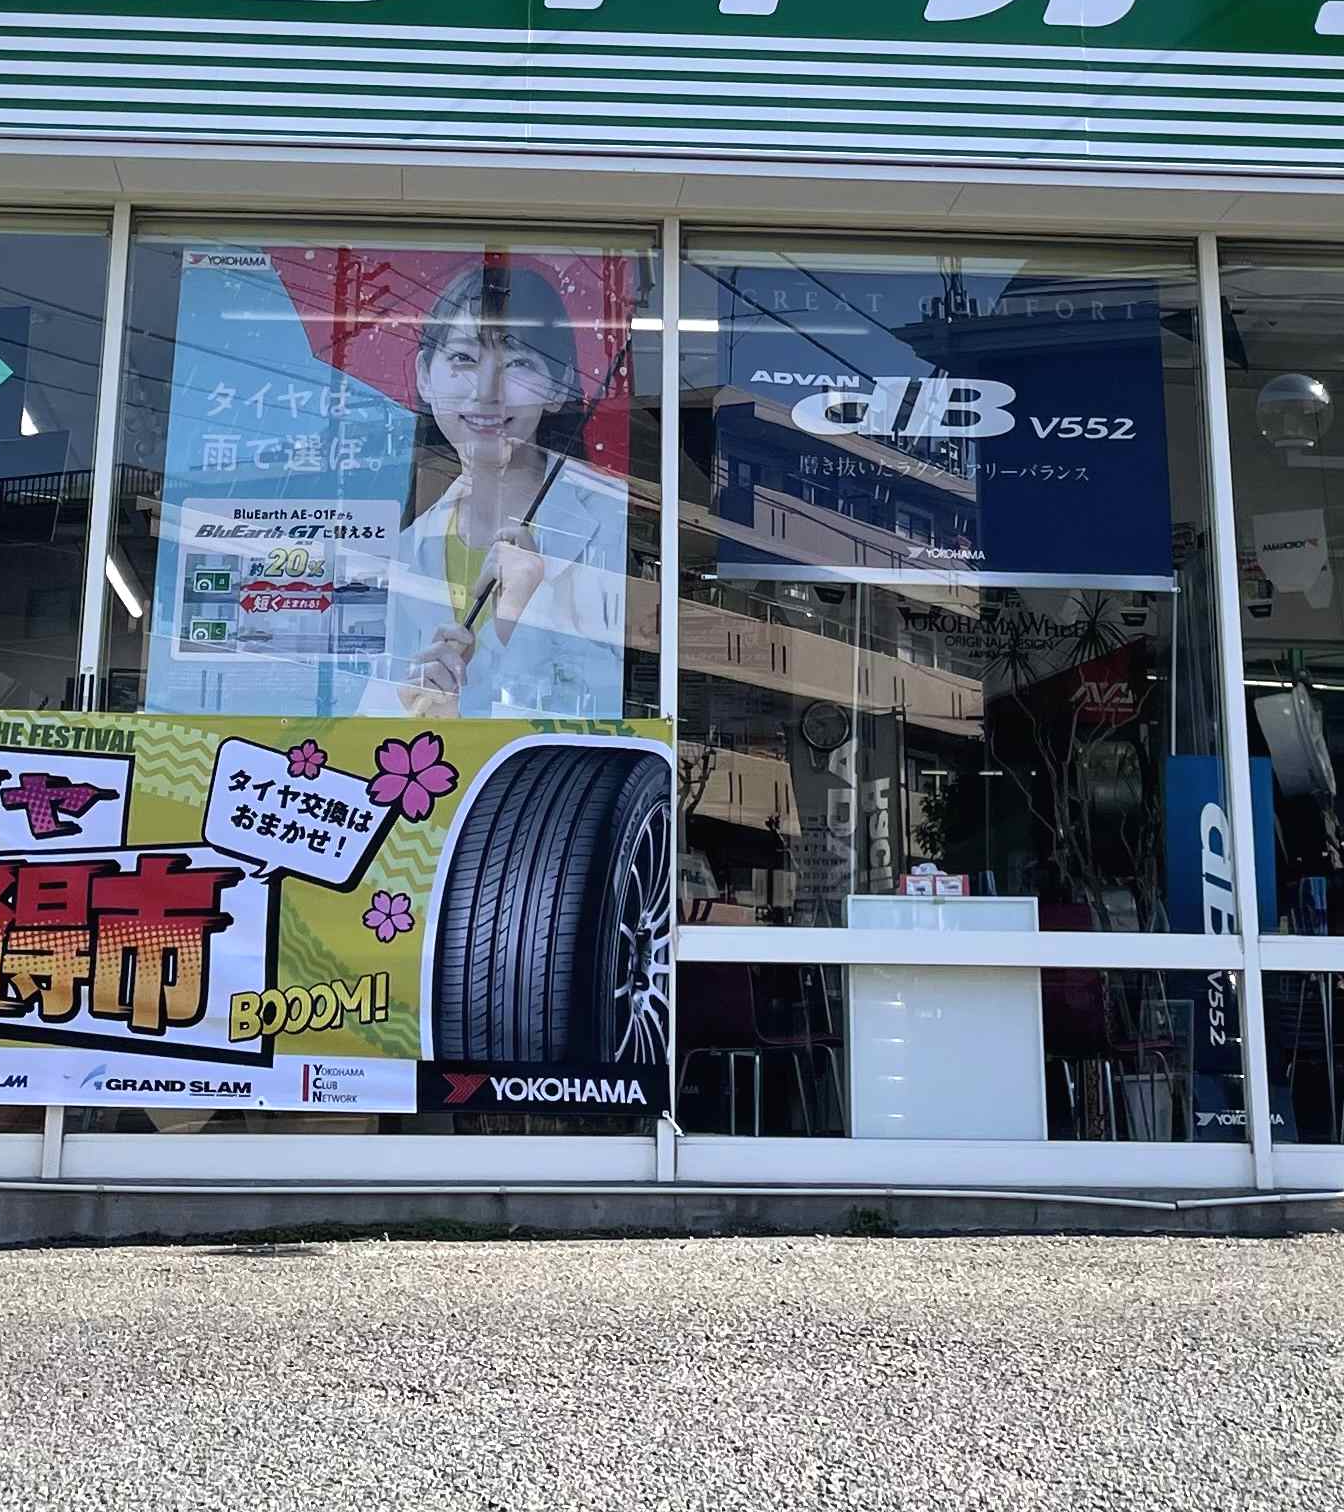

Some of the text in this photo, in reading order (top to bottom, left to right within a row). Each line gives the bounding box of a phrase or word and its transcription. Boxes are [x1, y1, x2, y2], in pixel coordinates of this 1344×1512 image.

[207, 254, 267, 267] YOKOHAMA
[750, 368, 860, 389] ADVAN
[790, 376, 1137, 441] dB V552
[233, 508, 288, 521] BluEarth
[925, 547, 987, 561] YOKOHAMA
[29, 717, 136, 754] FESTIVAL
[227, 768, 376, 835] タイヤ交換は
[230, 803, 348, 859] おまかせ！
[228, 971, 391, 1044] BOOOM!
[1206, 970, 1227, 1047] V552
[312, 1063, 366, 1077] YOKOHAMA
[105, 1078, 253, 1095] GRAND SLAM
[312, 1077, 339, 1090] CLUB
[489, 1076, 649, 1106] YOKOHAMA
[312, 1091, 359, 1104] NETWORK
[1216, 1113, 1285, 1126] YOKOMA
